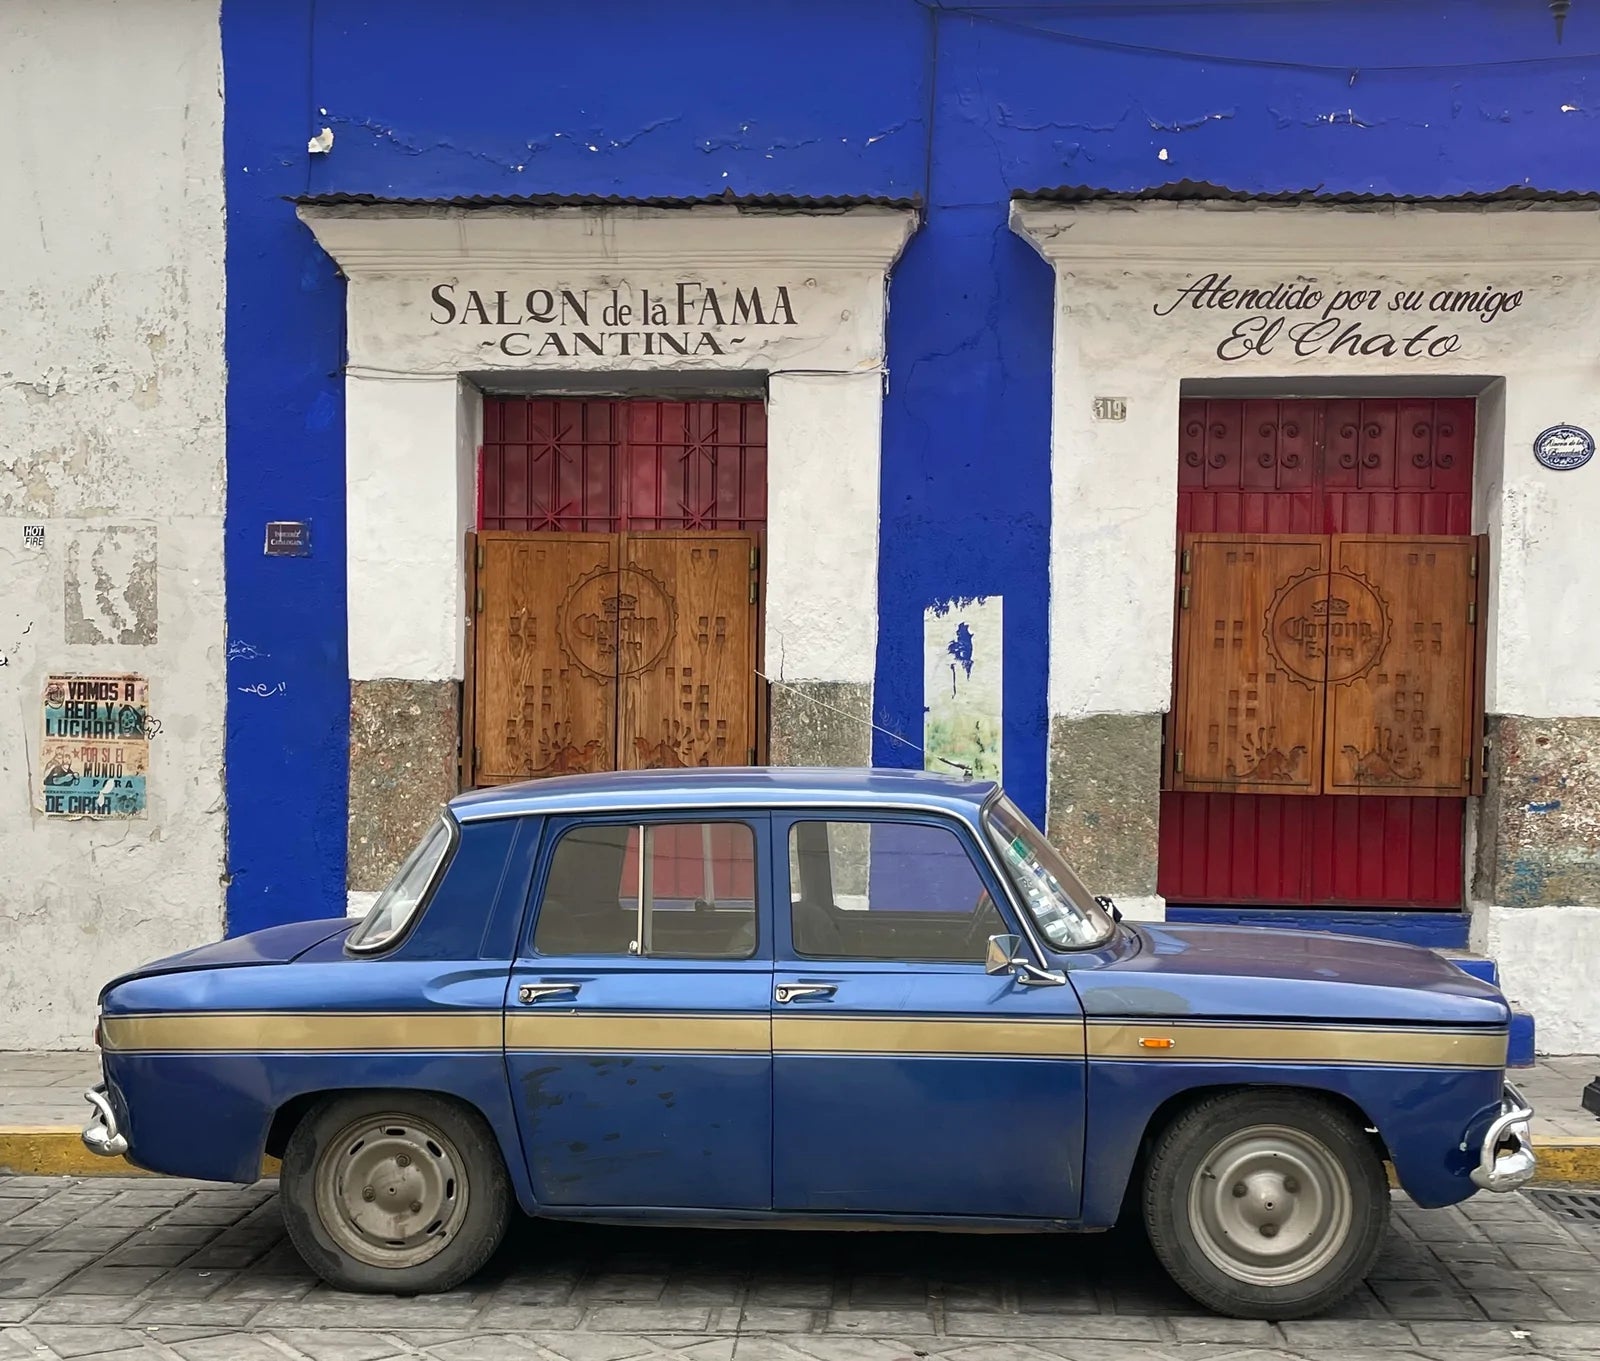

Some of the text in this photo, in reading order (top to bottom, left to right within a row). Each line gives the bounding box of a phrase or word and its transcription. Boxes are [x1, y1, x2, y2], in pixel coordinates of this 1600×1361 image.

[602, 289, 632, 326] de
[641, 289, 670, 326] la
[676, 282, 798, 326] FAMA
[1154, 273, 1523, 323] Atendido por su amigo
[500, 332, 727, 356] CANTINA
[1217, 316, 1462, 361] El Chato
[1095, 399, 1122, 419] 319
[25, 526, 44, 536] HOT
[25, 536, 44, 546] FIRE
[1280, 617, 1373, 646] Corona
[67, 682, 135, 701] VAMOS A
[65, 701, 115, 720] REIR Y
[46, 719, 116, 739] LUCHAR
[81, 746, 126, 763] POR SI EL
[84, 762, 123, 779] MUNDO
[46, 795, 65, 813] DE
